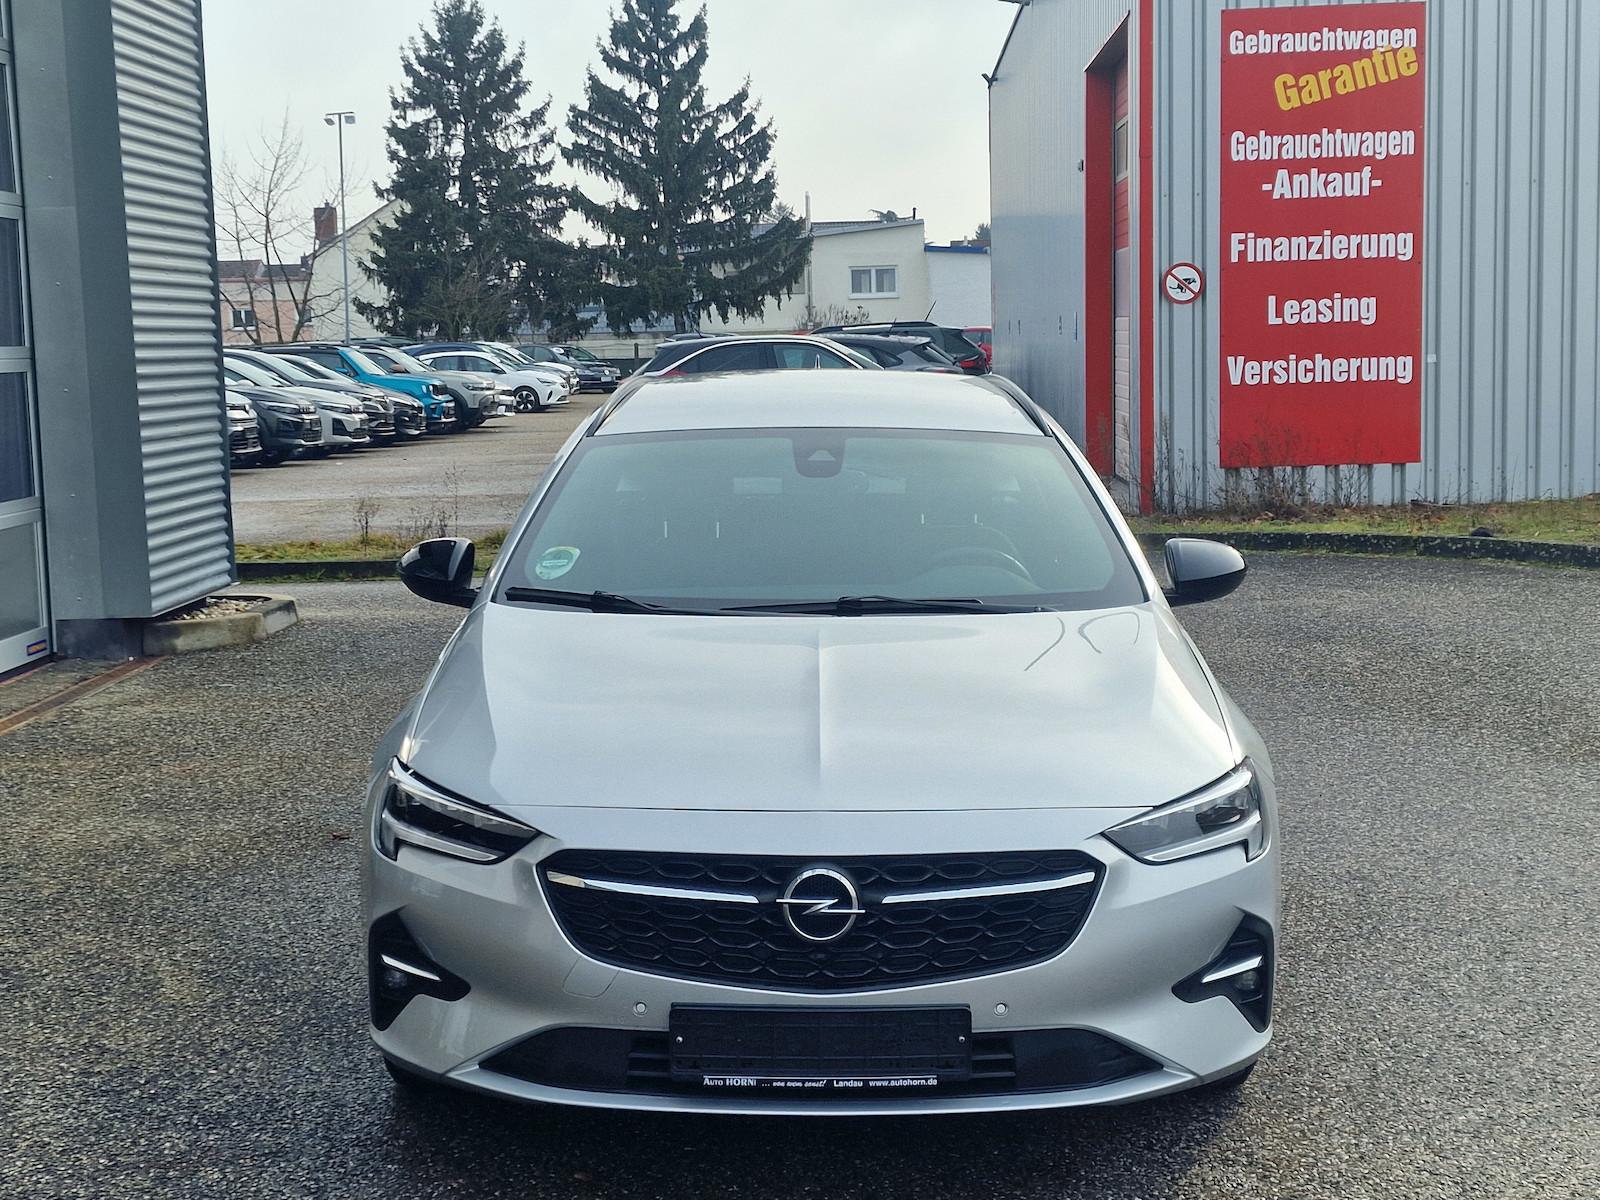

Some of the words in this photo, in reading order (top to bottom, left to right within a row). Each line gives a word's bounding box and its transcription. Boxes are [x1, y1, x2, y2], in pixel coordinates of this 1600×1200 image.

[1229, 27, 1417, 55] Gebrauchtwagen
[1274, 46, 1418, 111] Garantie
[1230, 128, 1415, 161] Gebrauchtwagen
[1261, 166, 1382, 199] -Ankauf-
[1230, 230, 1414, 263] Finanzierung
[1267, 292, 1377, 325] Leasing
[1227, 354, 1413, 385] Versicherung
[833, 1079, 863, 1088] Landau
